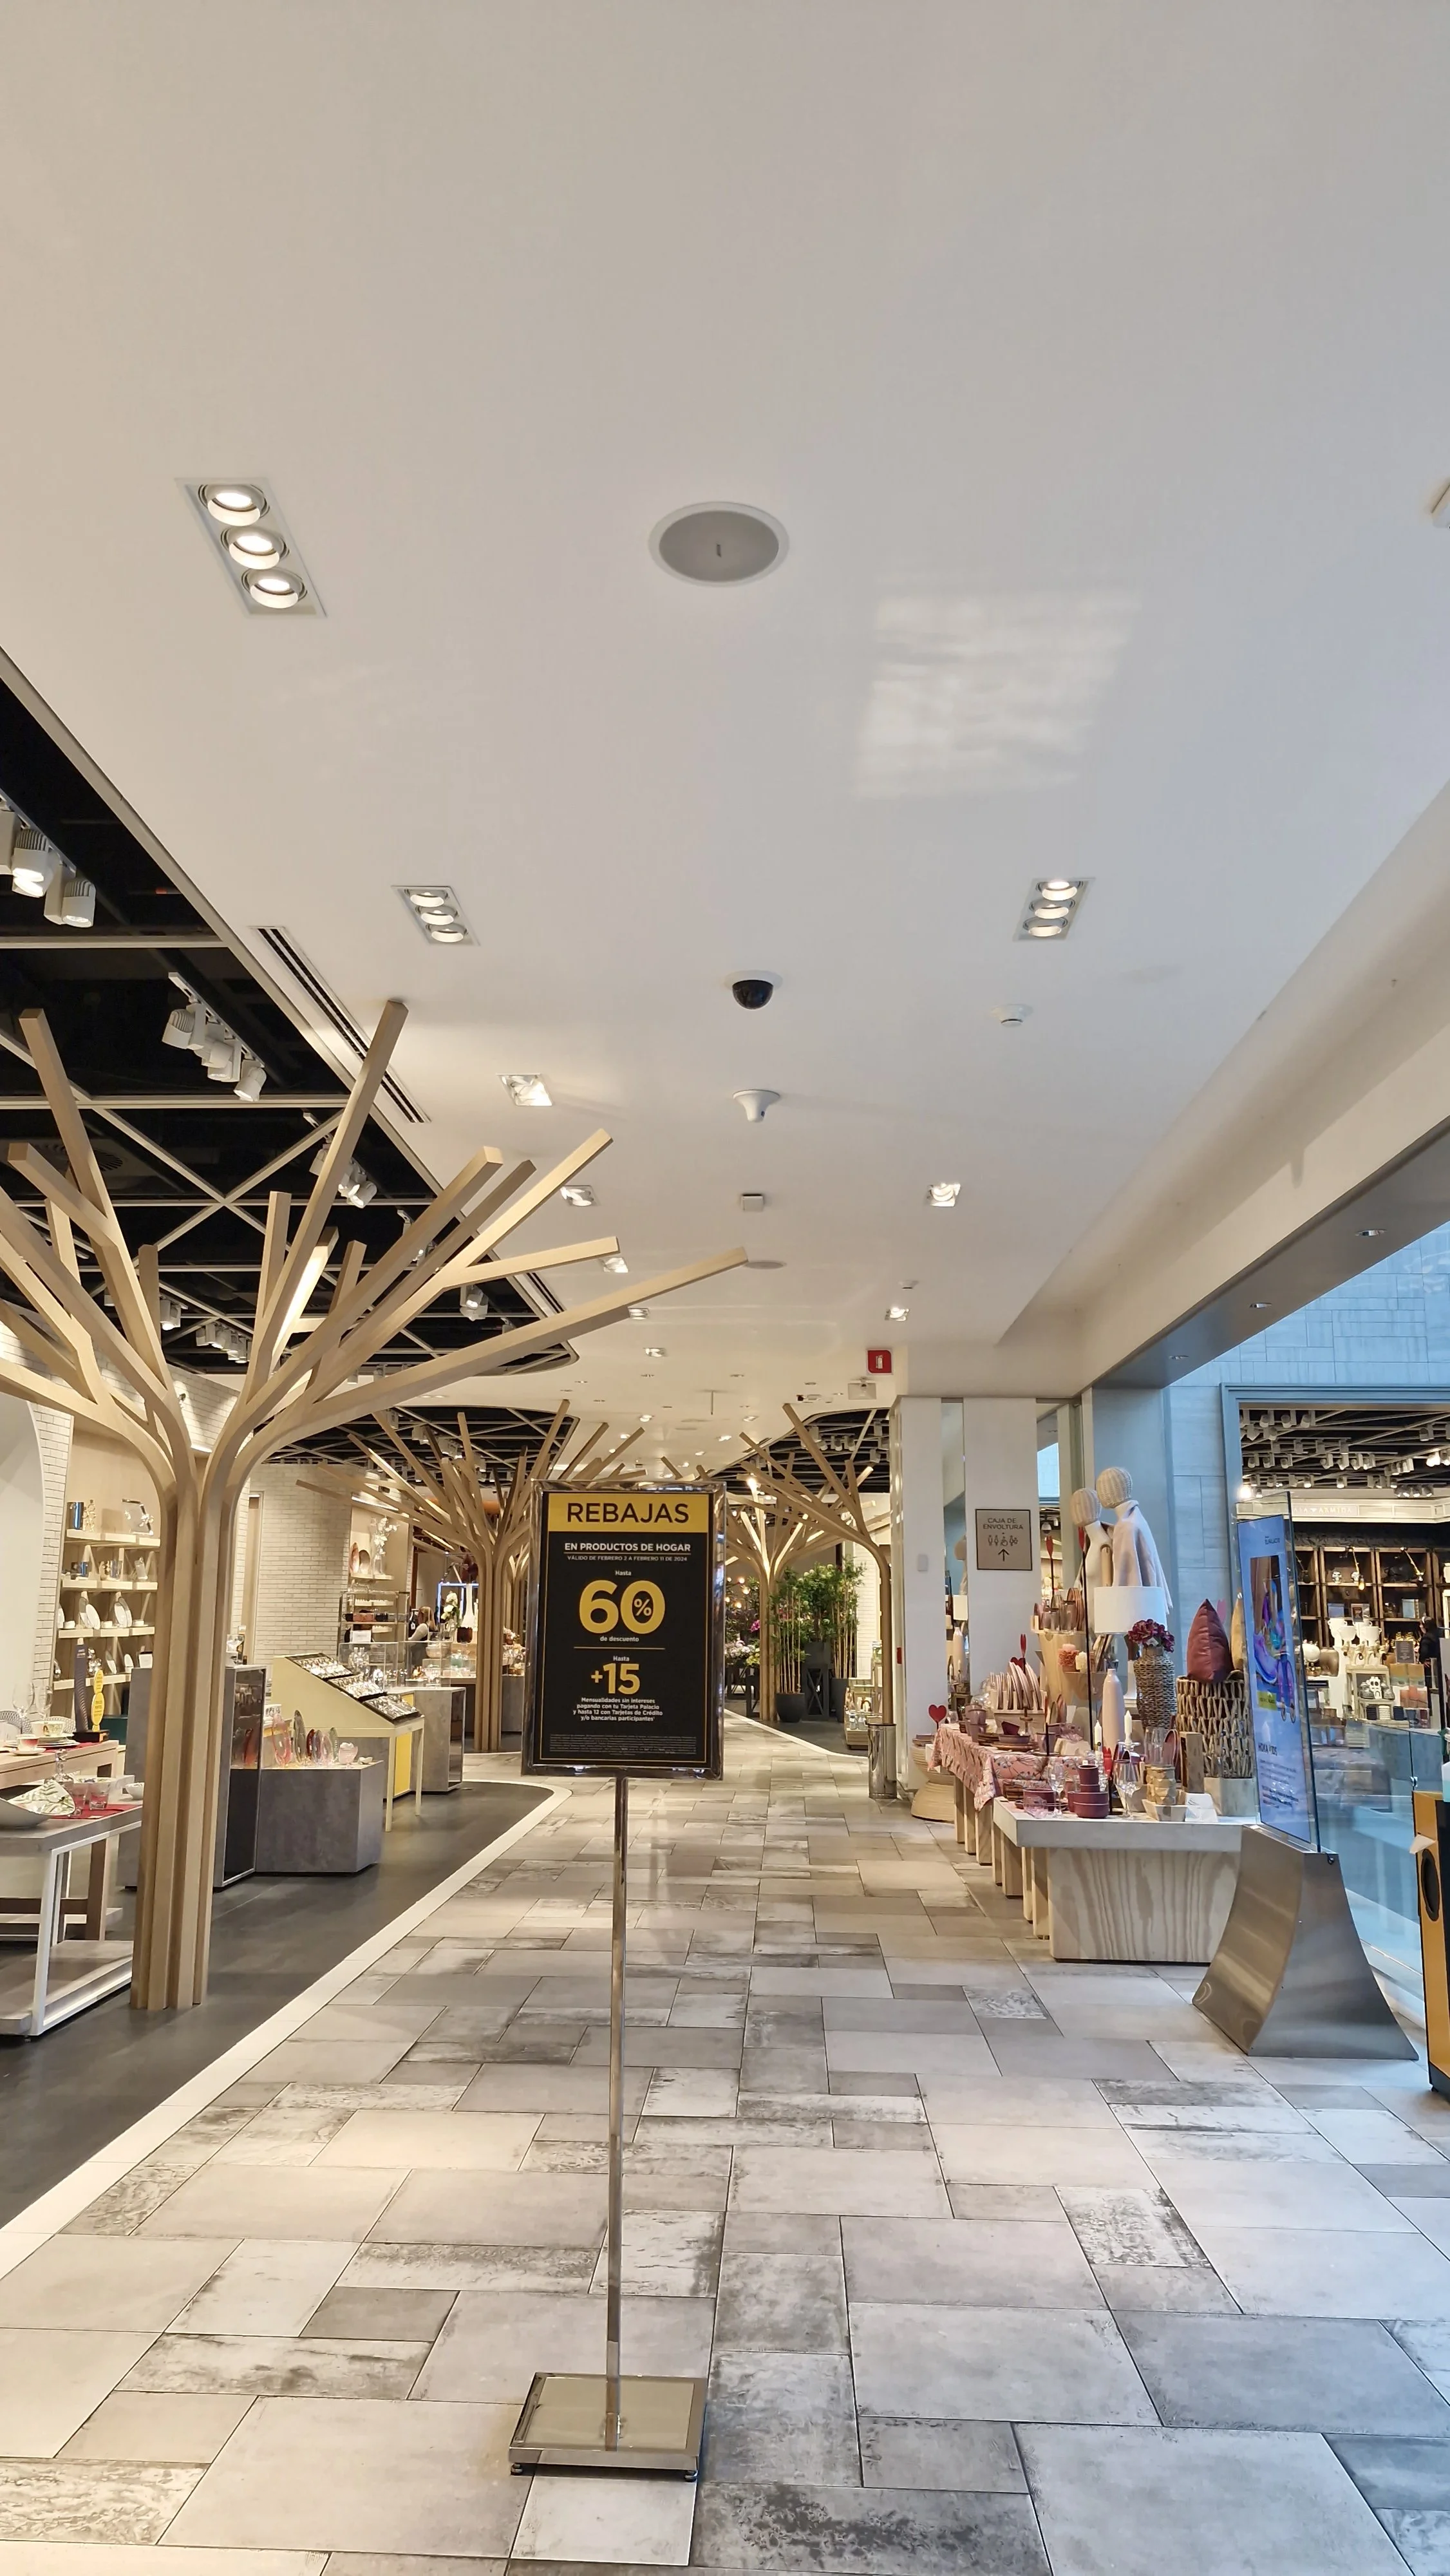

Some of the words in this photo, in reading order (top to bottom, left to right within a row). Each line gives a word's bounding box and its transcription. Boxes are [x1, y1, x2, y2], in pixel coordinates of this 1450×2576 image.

[567, 1502, 689, 1523] REBAJAS
[580, 1543, 639, 1551] PRODUCTOS
[656, 1544, 691, 1552] HOGAR
[591, 1663, 640, 1694] +15
